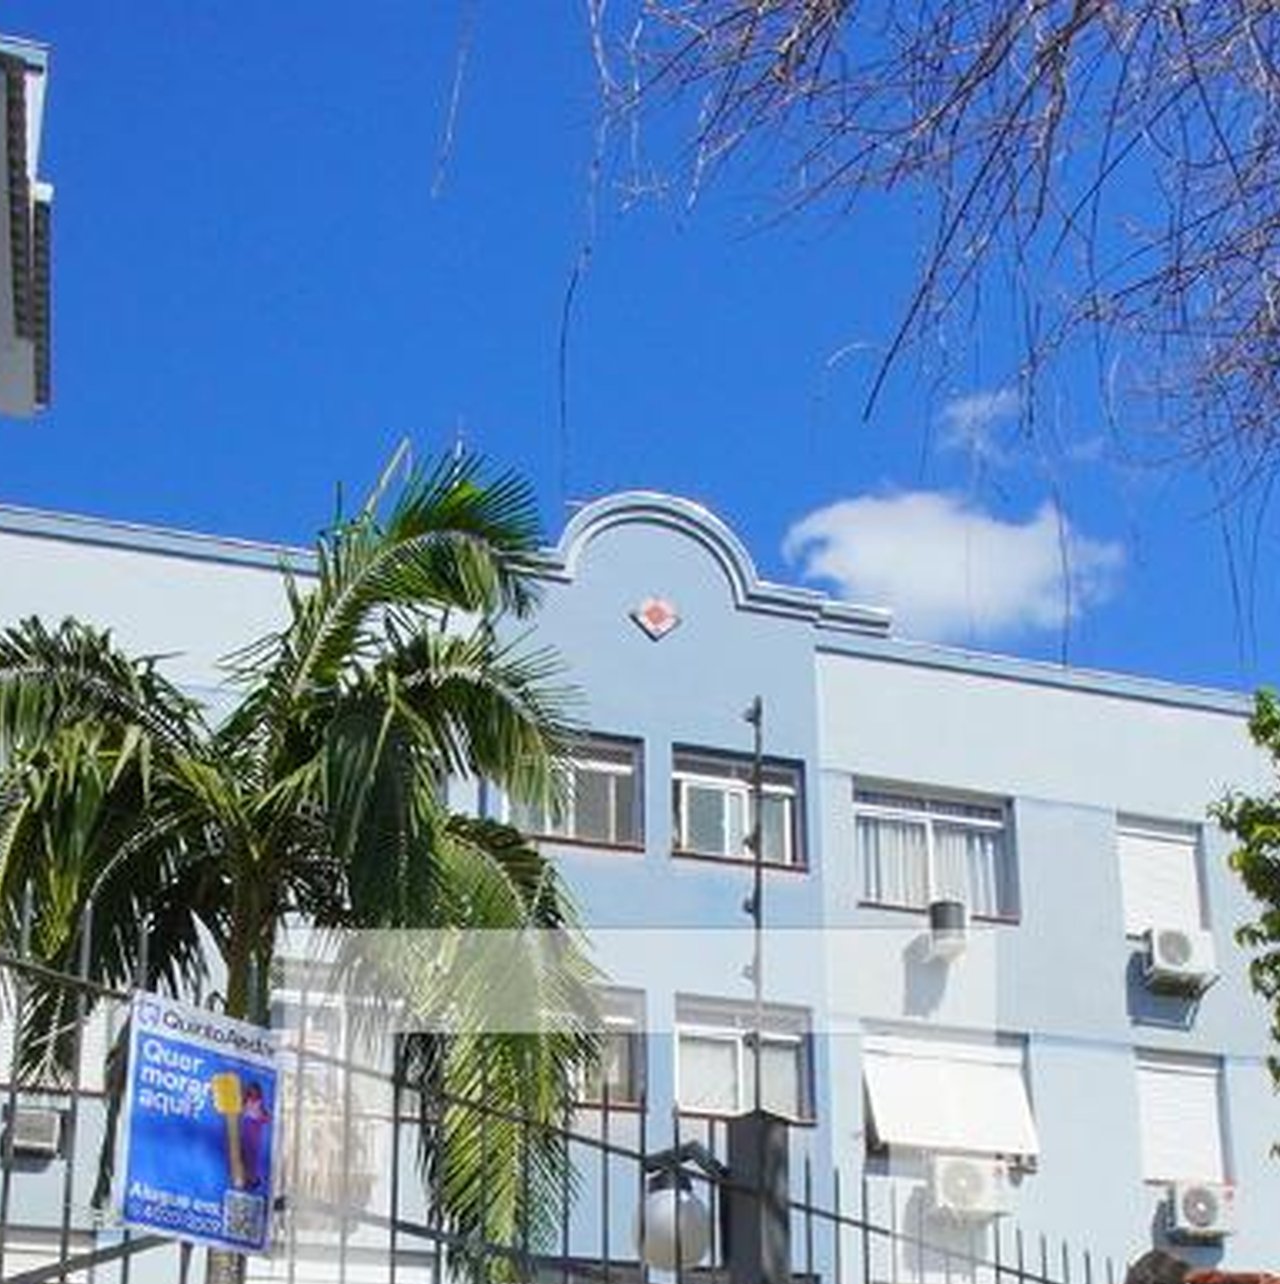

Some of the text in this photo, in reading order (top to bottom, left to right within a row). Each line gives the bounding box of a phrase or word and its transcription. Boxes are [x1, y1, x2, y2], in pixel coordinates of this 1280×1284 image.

[142, 1039, 205, 1074] Quer
[140, 1066, 210, 1097] morar
[138, 1088, 204, 1119] aqui?
